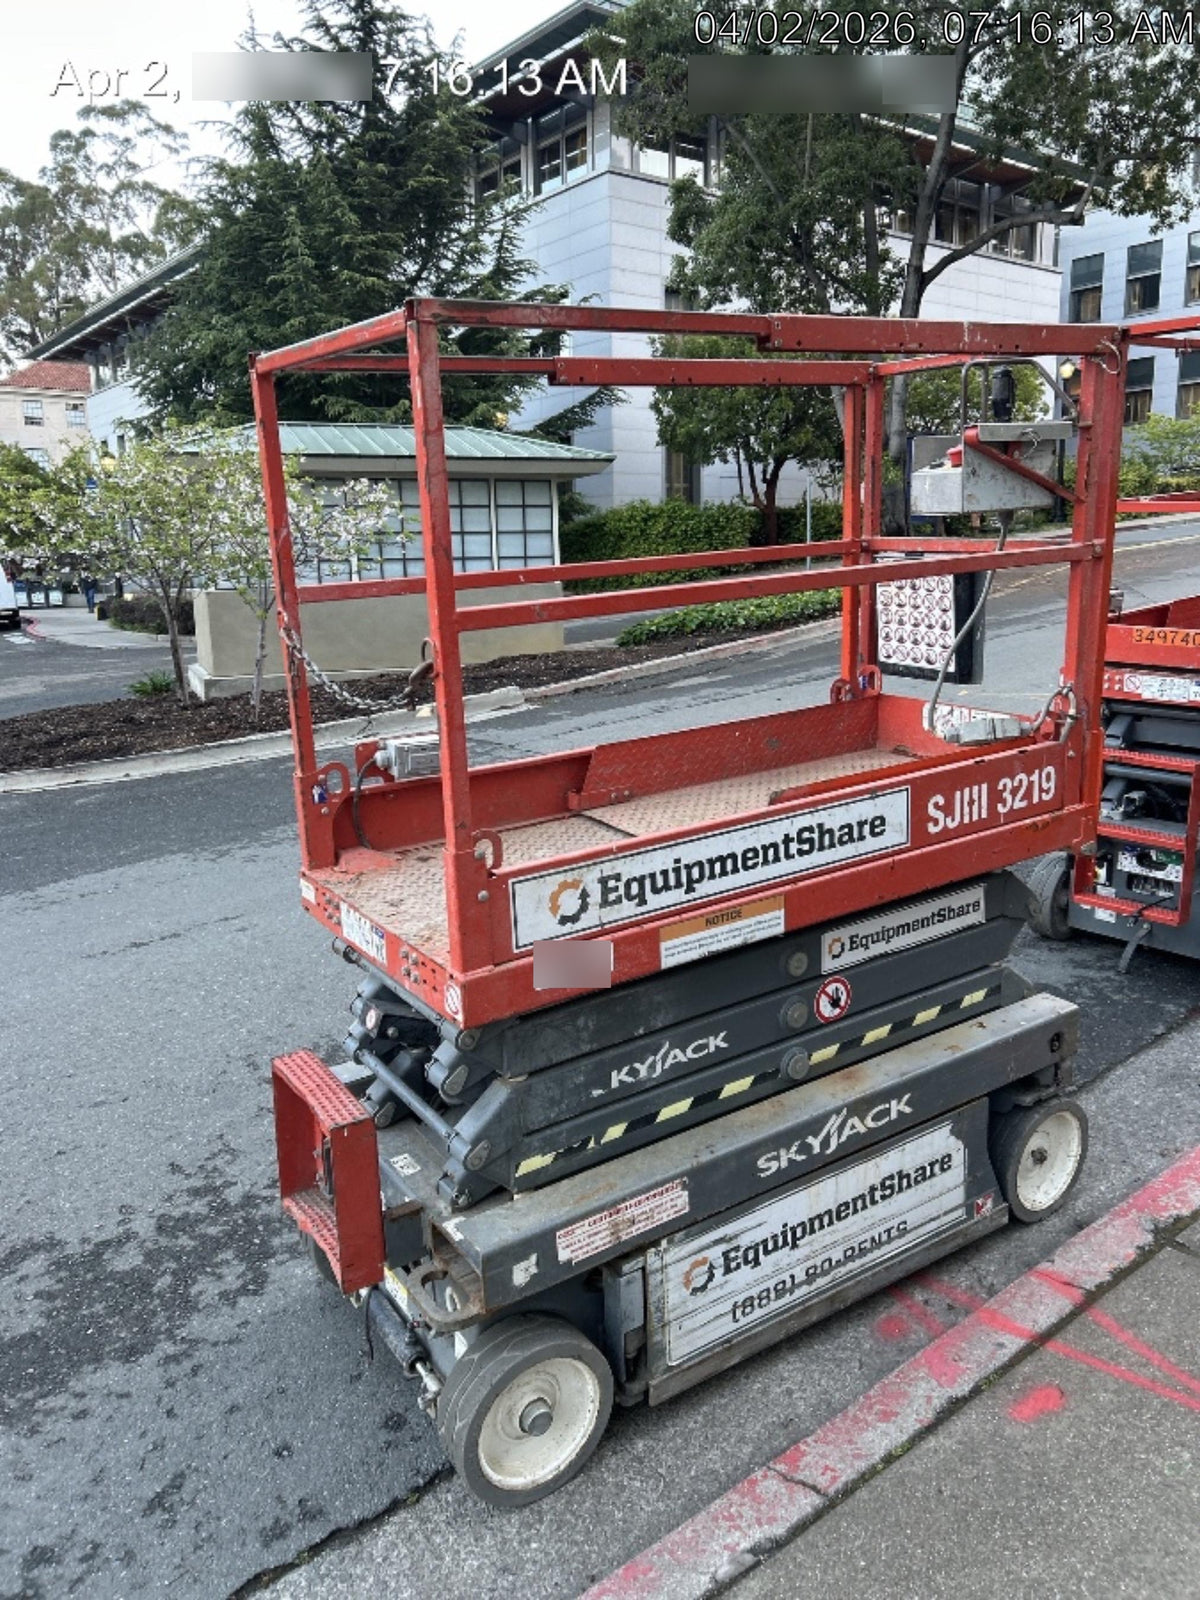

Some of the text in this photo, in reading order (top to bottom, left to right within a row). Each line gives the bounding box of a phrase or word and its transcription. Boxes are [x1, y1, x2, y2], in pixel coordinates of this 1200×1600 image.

[997, 765, 1056, 813] 3219
[597, 814, 886, 908] EquipmentShare
[705, 909, 742, 927] NOTICE
[848, 899, 981, 951] EquipmentShare
[590, 1031, 729, 1097] KYJACK
[757, 1093, 913, 1178] SKYJACK
[721, 1153, 953, 1276] EquipmentShare
